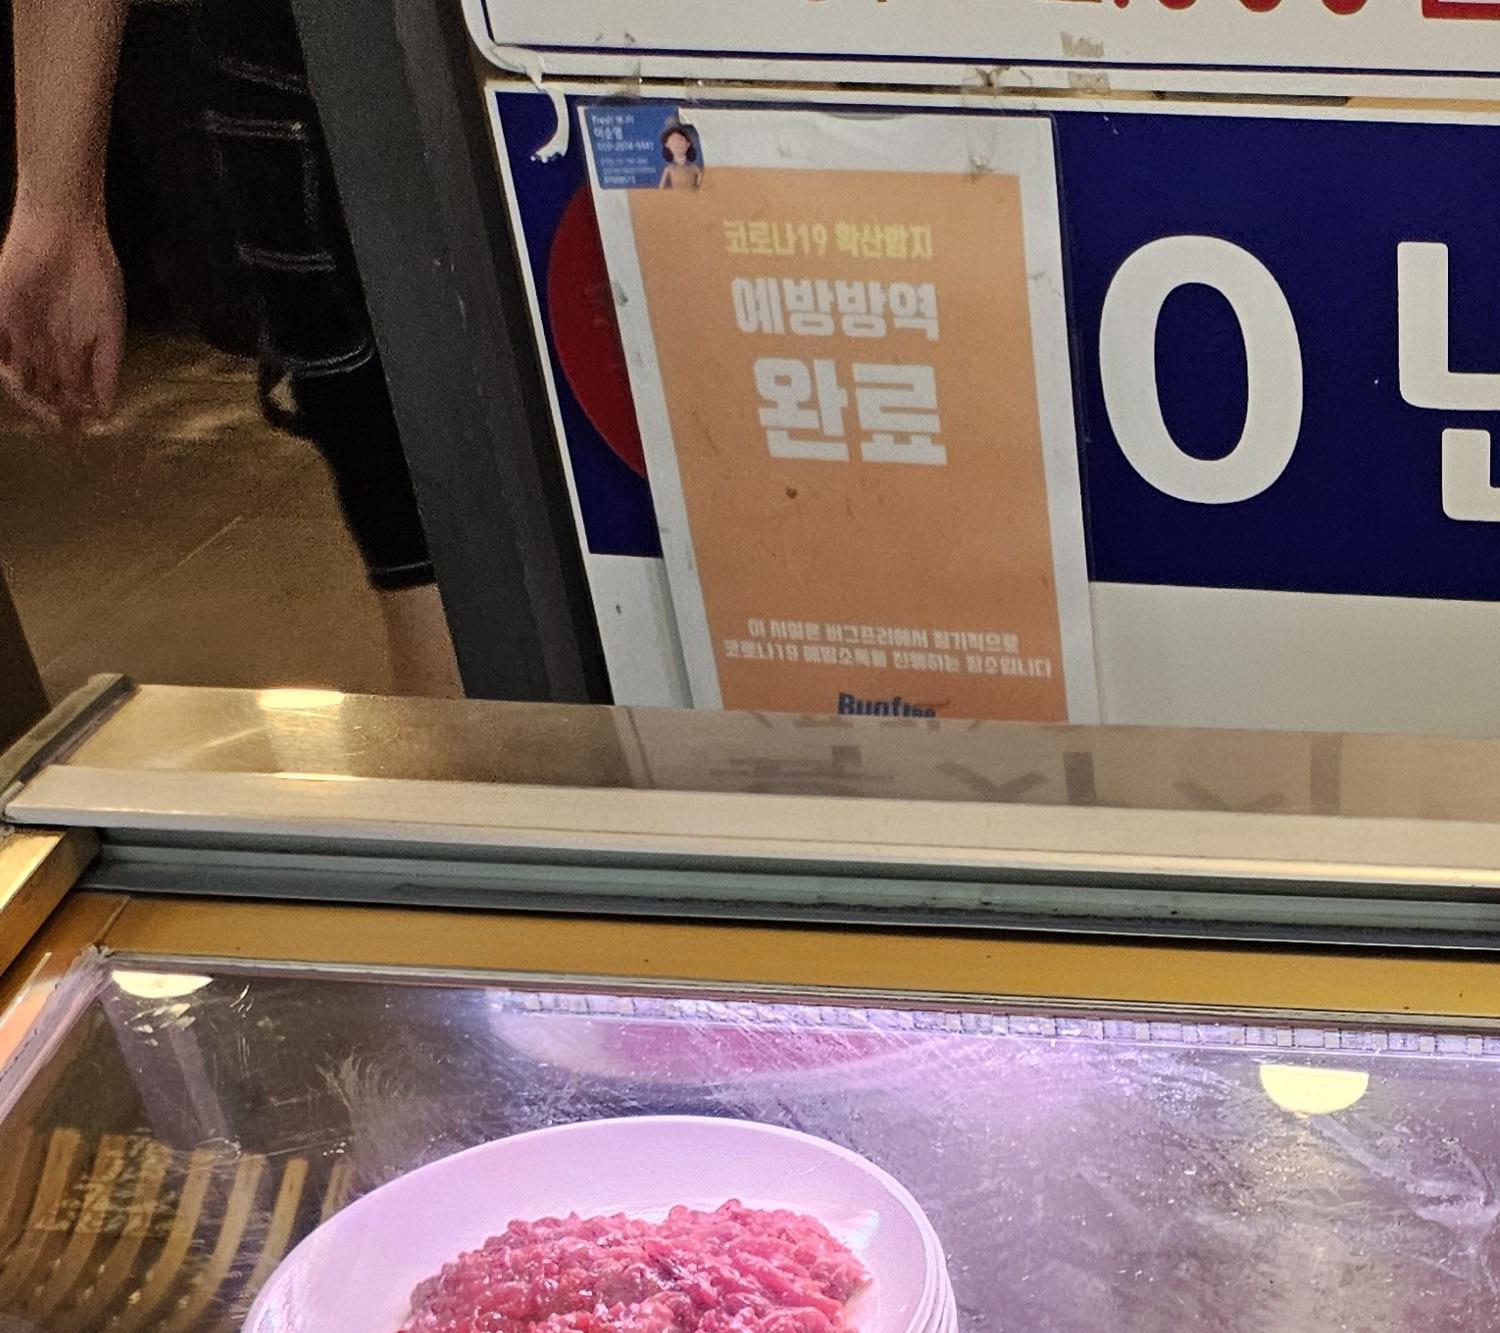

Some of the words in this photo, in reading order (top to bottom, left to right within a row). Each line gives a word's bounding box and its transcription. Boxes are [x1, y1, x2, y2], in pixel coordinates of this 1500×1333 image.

[723, 219, 829, 257] 코로나19
[834, 220, 934, 260] 확산방지
[730, 276, 940, 341] 예방방역
[753, 357, 948, 466] 완료
[723, 639, 799, 662] 코로나19
